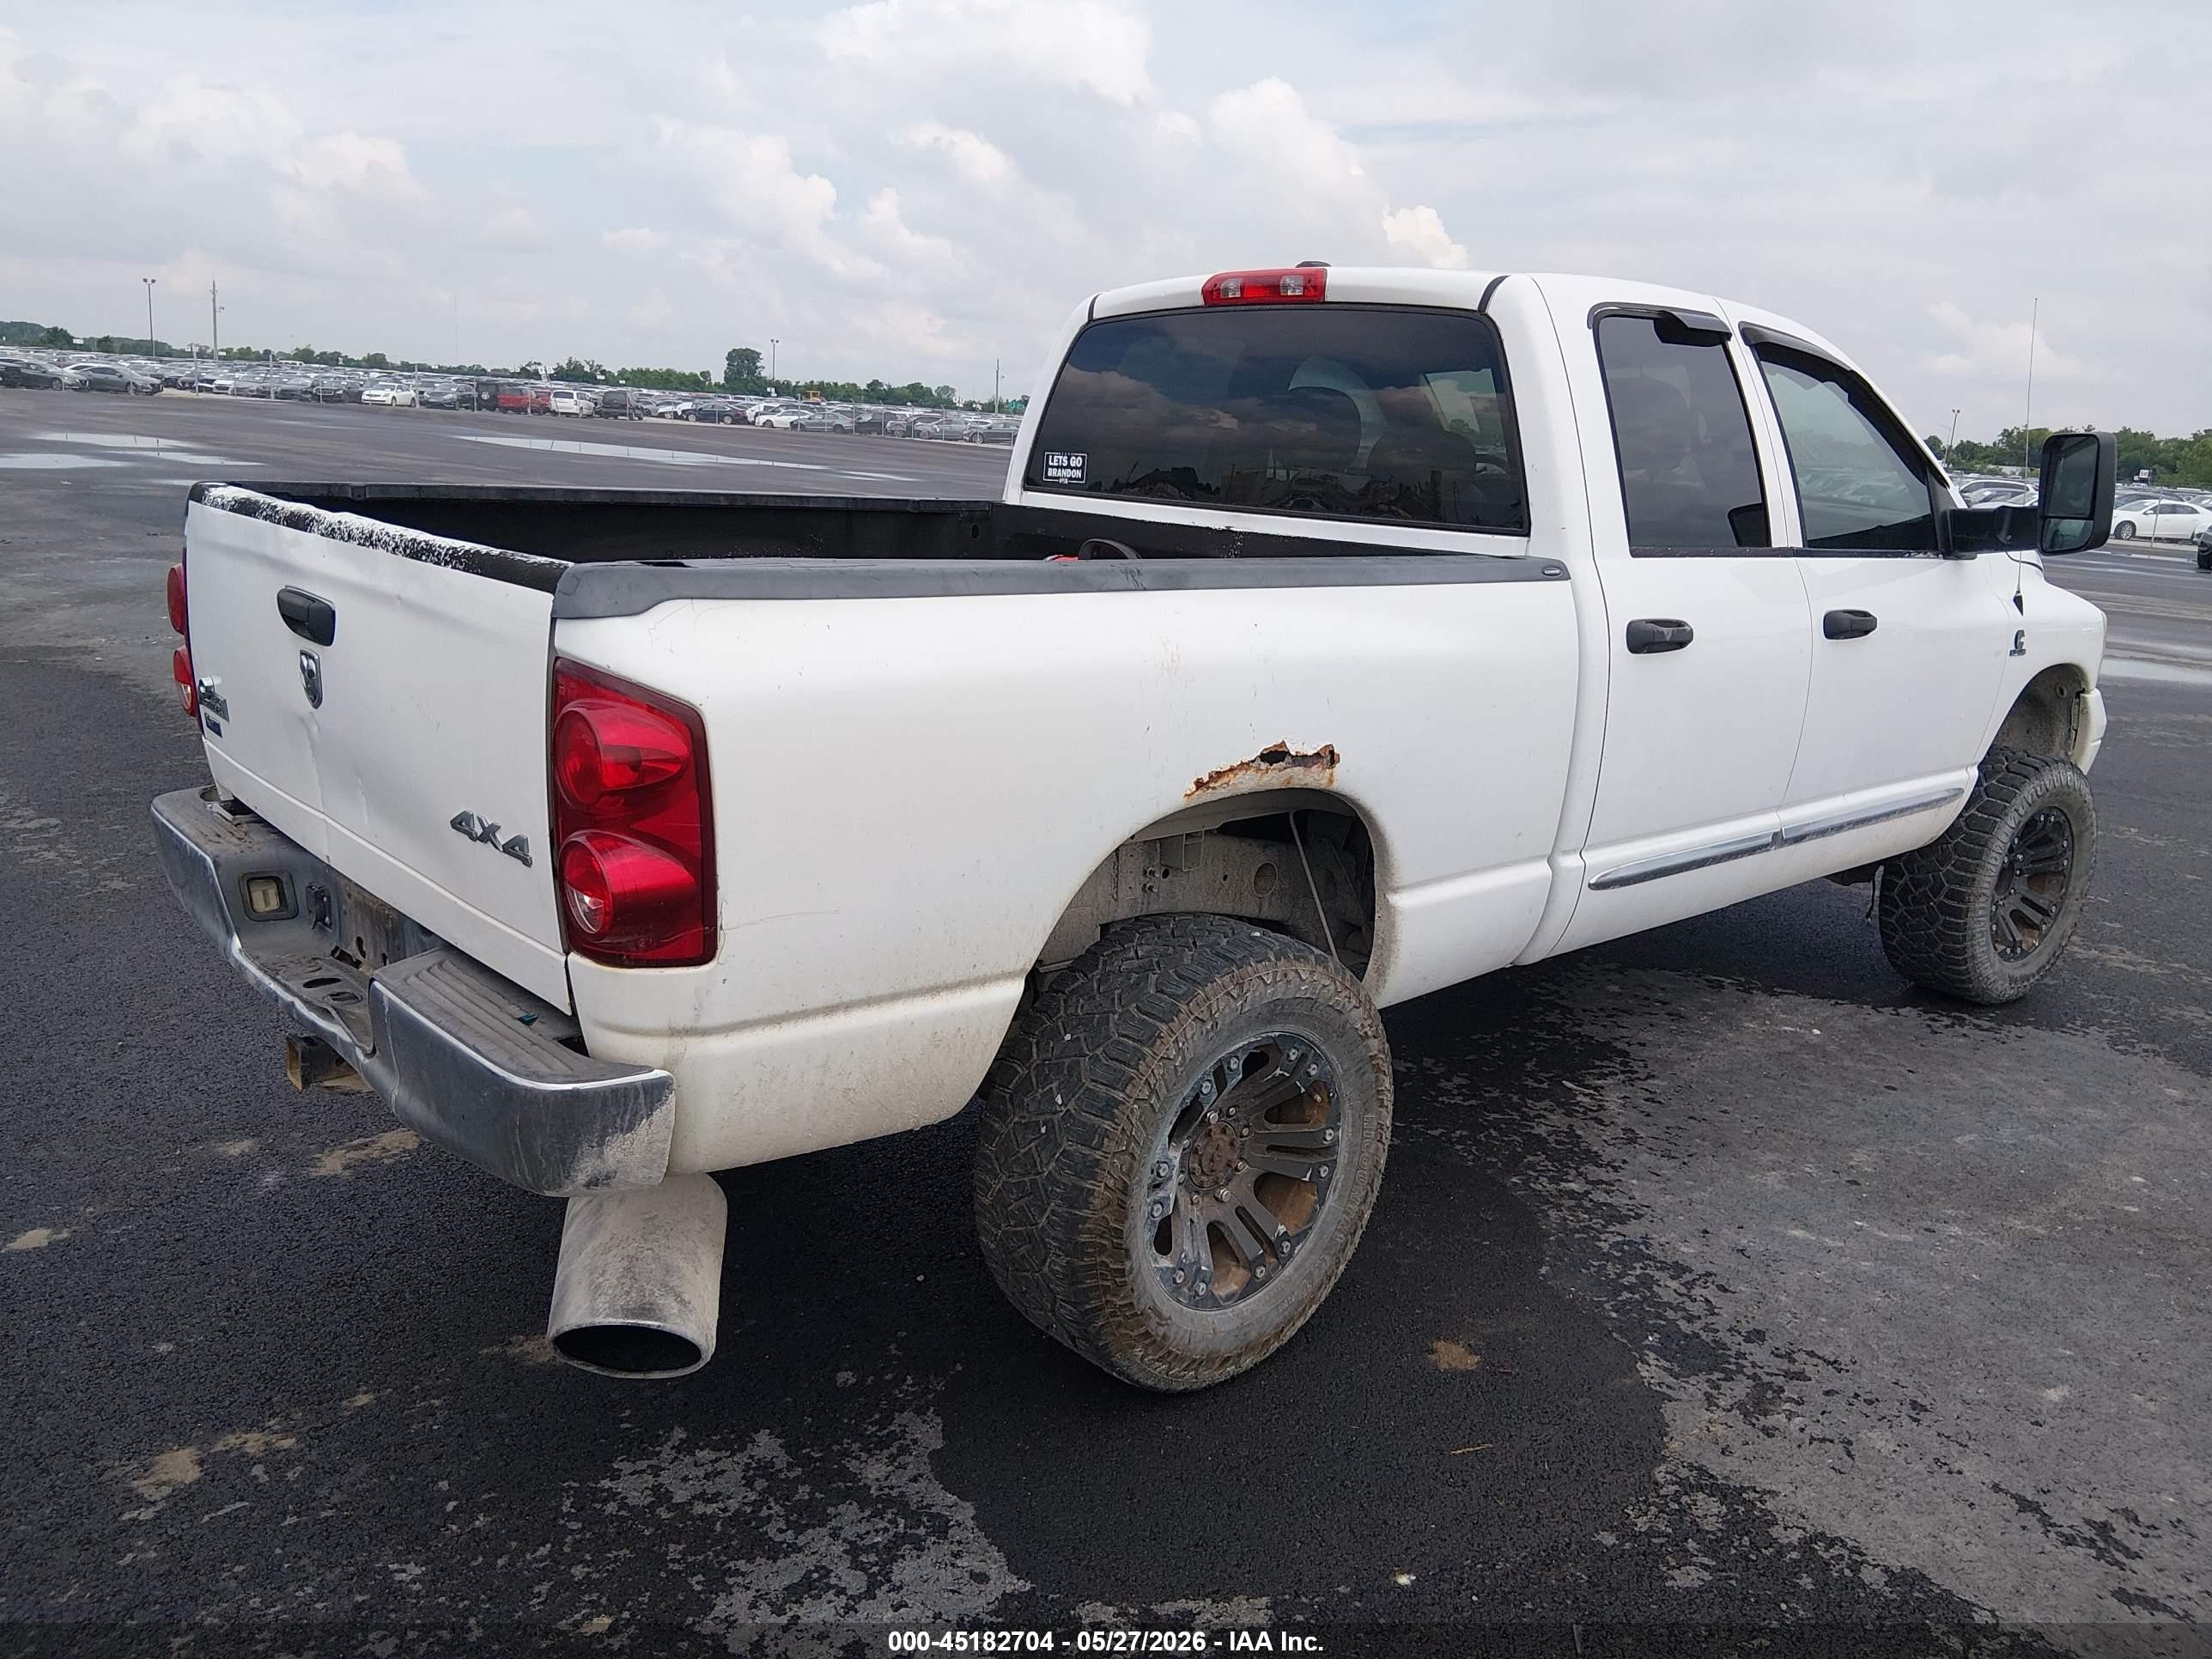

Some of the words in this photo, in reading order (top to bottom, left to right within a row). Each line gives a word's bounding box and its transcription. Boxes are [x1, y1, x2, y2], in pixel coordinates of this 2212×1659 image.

[1048, 455, 1068, 466] LETS
[1070, 456, 1082, 467] GO
[1048, 468, 1082, 478] BRANDON
[450, 810, 532, 868] 4X4
